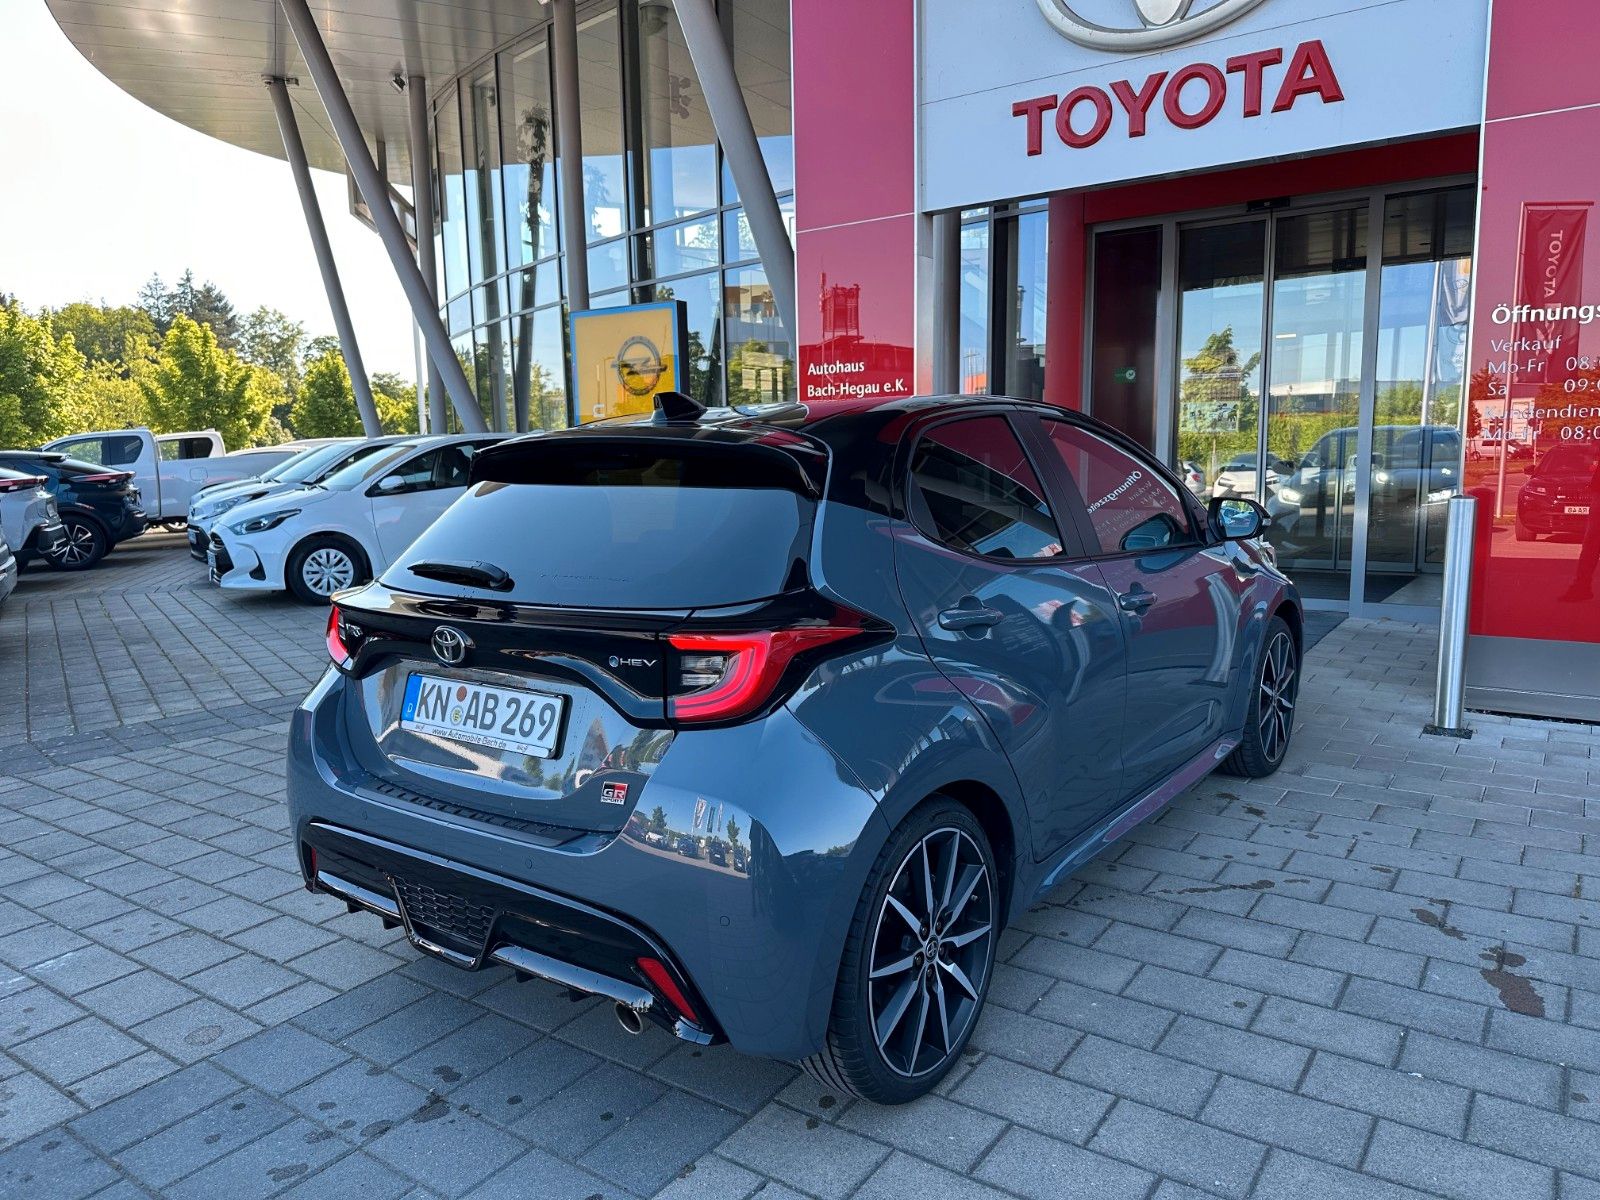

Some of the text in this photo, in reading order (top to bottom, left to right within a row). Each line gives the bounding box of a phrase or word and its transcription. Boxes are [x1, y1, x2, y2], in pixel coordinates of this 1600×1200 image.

[1012, 39, 1345, 157] TOYOTA
[1544, 229, 1563, 299] TOYOTA
[1490, 334, 1562, 353] Verkauf
[807, 360, 865, 376] Autohaus
[1488, 356, 1600, 374] Mo-Fr 08:
[807, 378, 908, 398] Bach-Hegau e.K.
[1487, 381, 1508, 396] Sa
[620, 657, 658, 668] HEV
[416, 682, 452, 722] KN
[463, 691, 500, 732] AB
[500, 699, 556, 741] 269
[603, 788, 625, 799] GR
